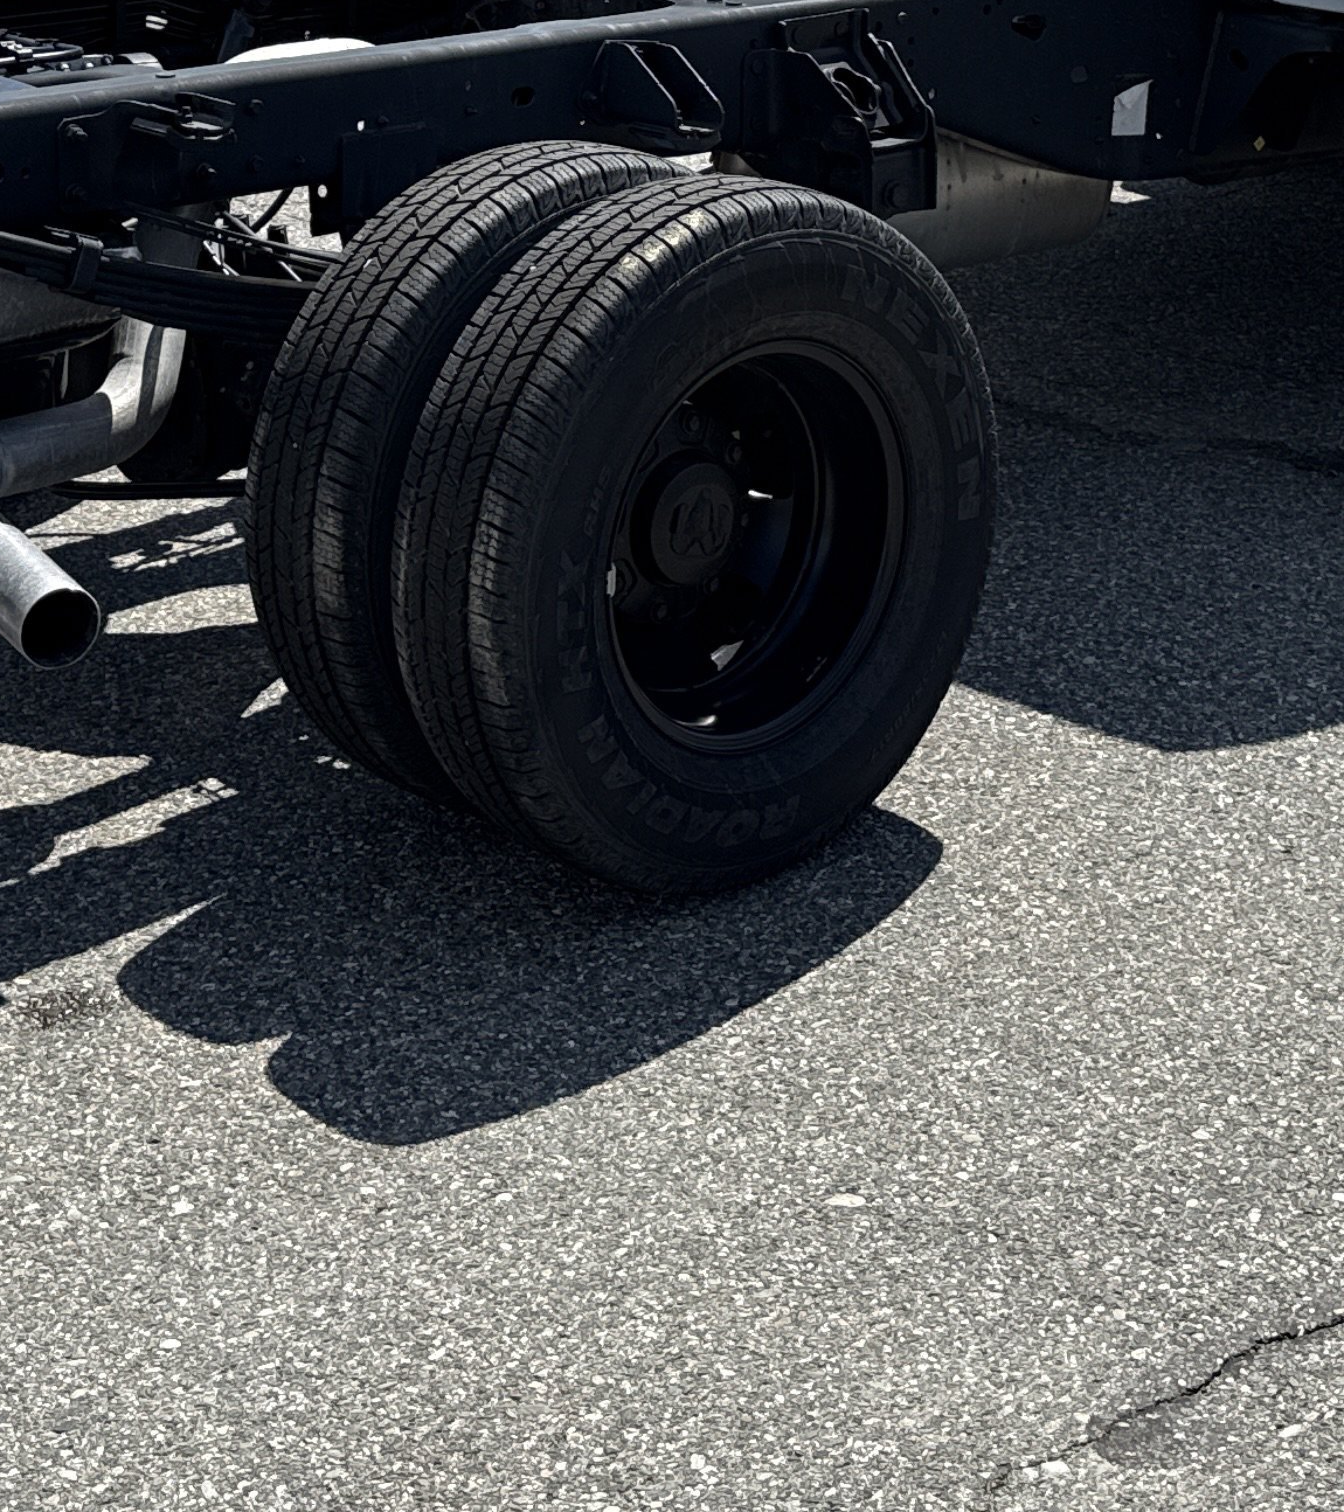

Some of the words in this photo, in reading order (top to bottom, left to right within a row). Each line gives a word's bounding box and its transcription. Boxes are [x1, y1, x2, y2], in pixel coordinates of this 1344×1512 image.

[840, 260, 984, 522] NEXEN
[554, 551, 595, 696] HTX
[578, 714, 803, 849] ROADIAN
